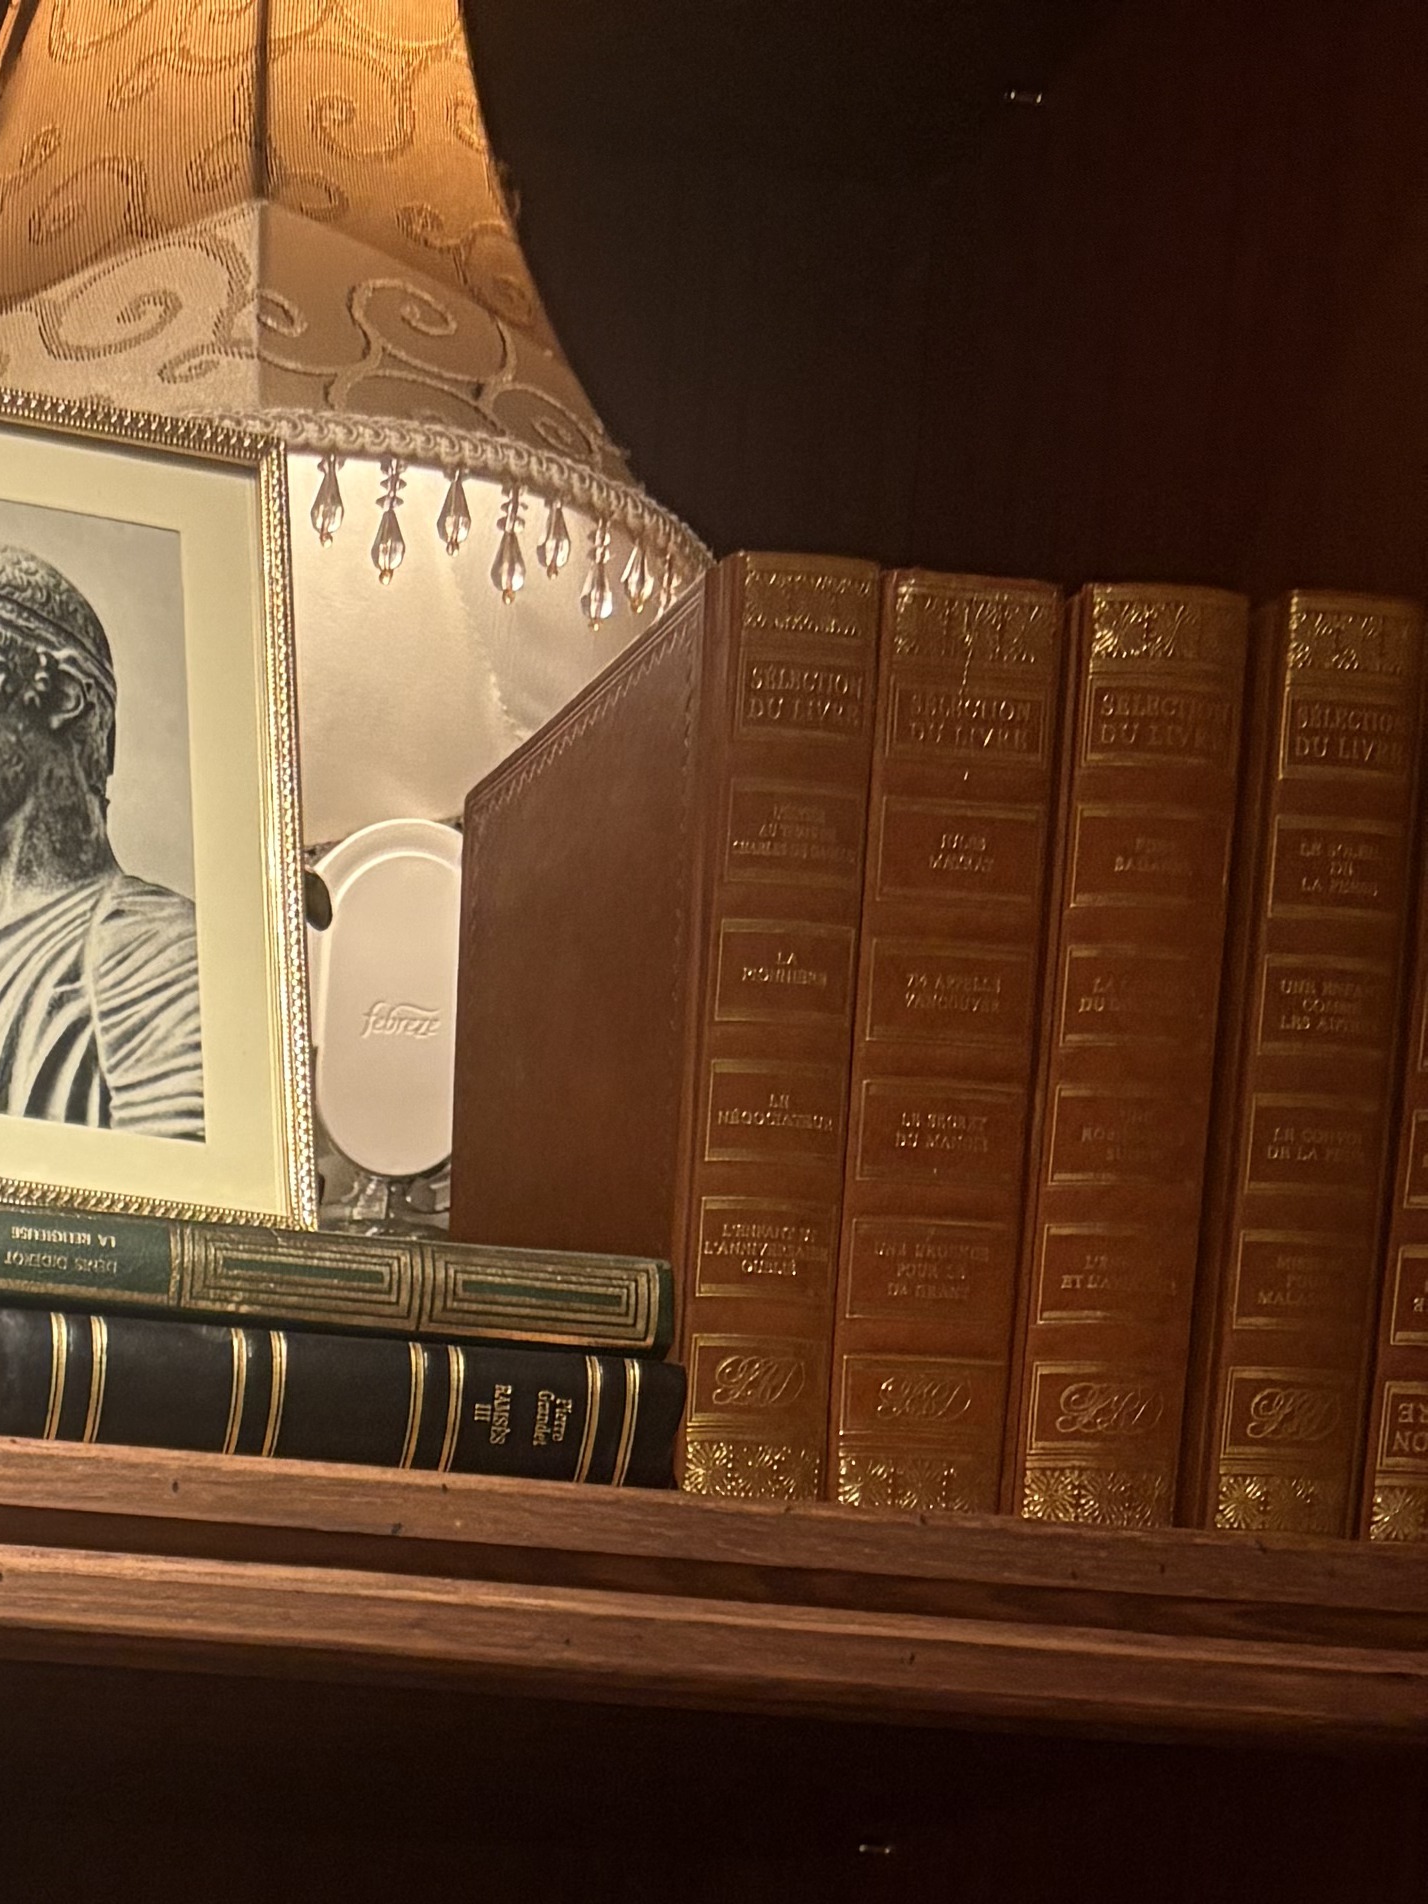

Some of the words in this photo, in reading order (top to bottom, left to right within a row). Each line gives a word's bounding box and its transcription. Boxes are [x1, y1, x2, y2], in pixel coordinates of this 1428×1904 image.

[746, 697, 785, 721] DU
[1294, 734, 1330, 758] DU
[360, 1000, 442, 1039] febreze
[10, 1225, 92, 1247] RELIGIEUSE
[97, 1232, 117, 1249] LA
[3, 1250, 69, 1271] DIDEROT
[73, 1256, 118, 1275] DENIS
[473, 1403, 492, 1423] III
[488, 1383, 513, 1445] RAMSÈS
[532, 1389, 555, 1446] Grandet
[551, 1398, 573, 1442] Pierre
